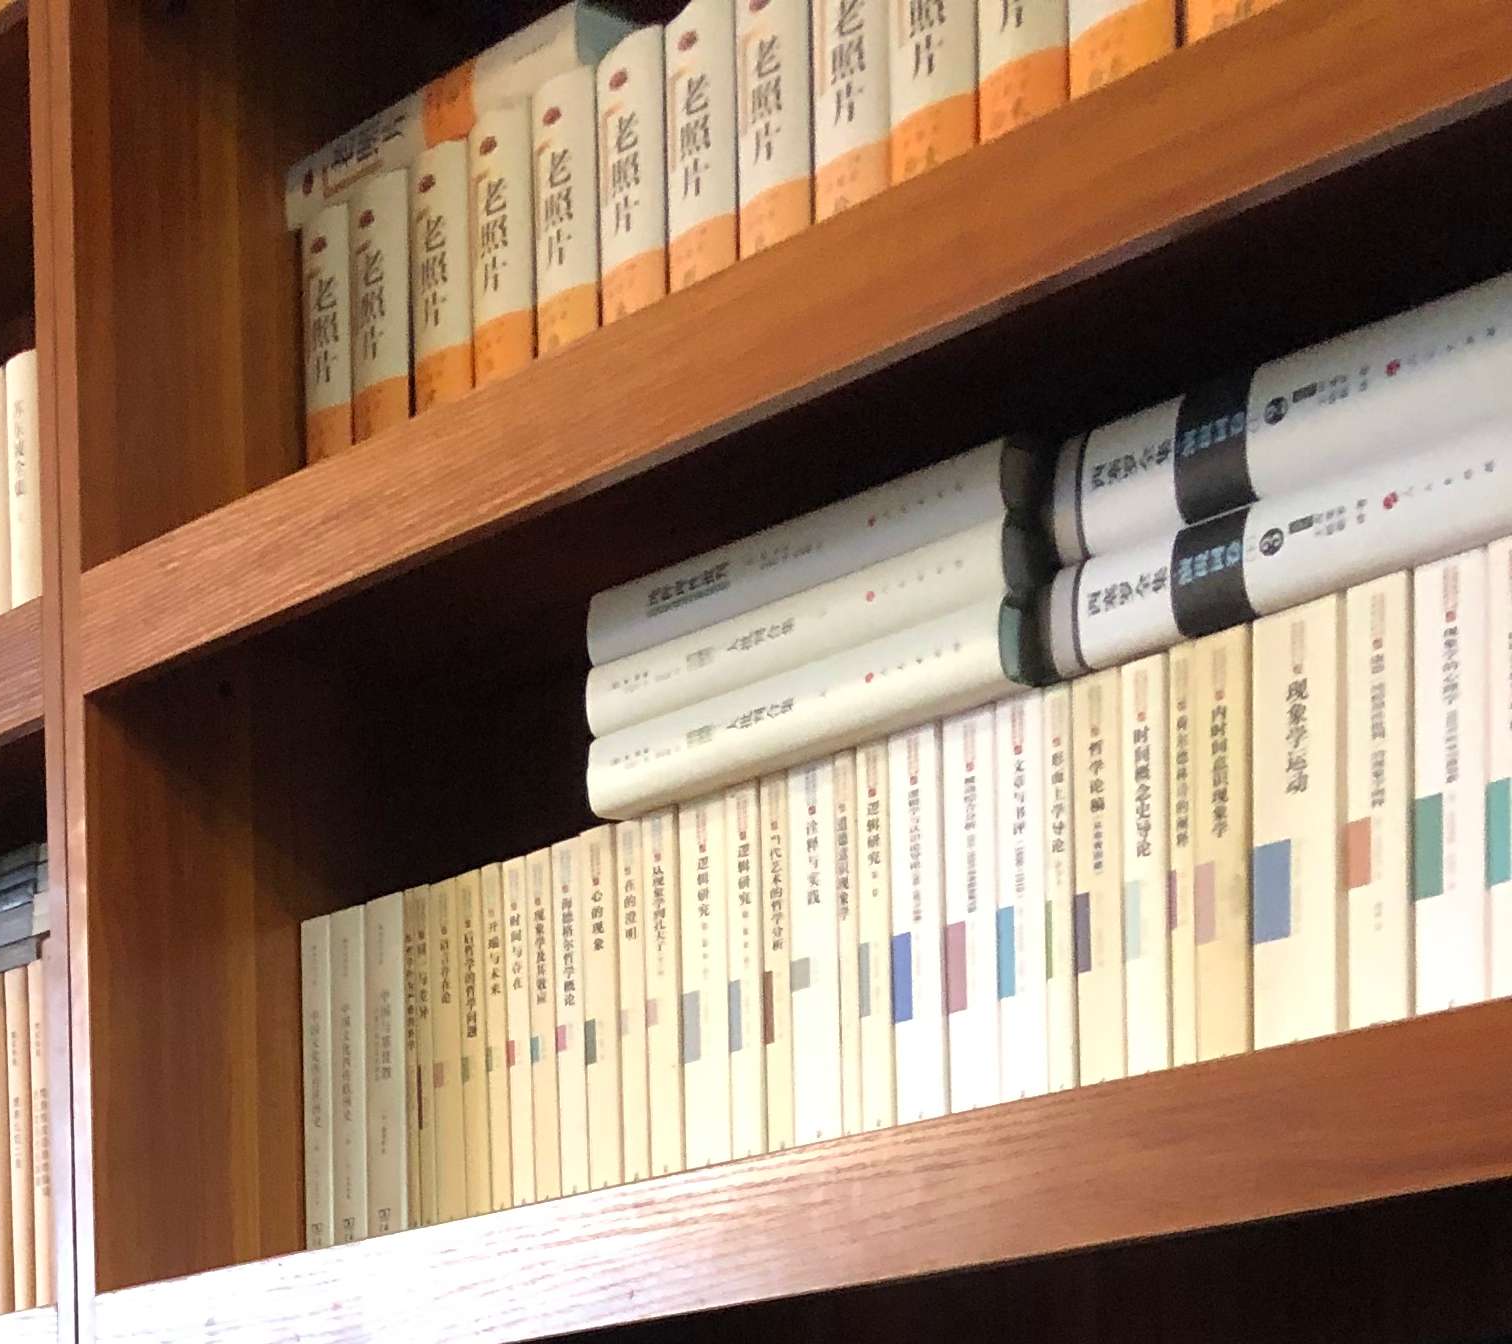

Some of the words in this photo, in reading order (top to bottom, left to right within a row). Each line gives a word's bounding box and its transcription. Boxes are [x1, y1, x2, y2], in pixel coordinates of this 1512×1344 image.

[751, 34, 782, 166] 老照片
[830, 0, 866, 128] 老照片
[610, 112, 640, 237] 老照片
[680, 73, 710, 200] 老照片
[480, 177, 509, 292] 老照片
[545, 148, 574, 266] 老照片
[358, 250, 385, 360] 老照片
[421, 215, 448, 327] 老照片
[311, 276, 339, 384] 老照片
[1088, 739, 1105, 813] 哲学论稿
[1285, 678, 1310, 795] 现象学运动
[867, 800, 881, 866] 逻辑研究
[1013, 759, 1026, 836] 文章与书评
[1052, 751, 1065, 854] 形而上学导论
[1133, 726, 1151, 858] 时间概念史导论
[624, 878, 637, 940] 在的澄明
[696, 856, 711, 918] 逻辑研究
[737, 843, 752, 906] 逻辑研究
[806, 820, 821, 906] 诠释与实践
[591, 889, 605, 952] 心的现象
